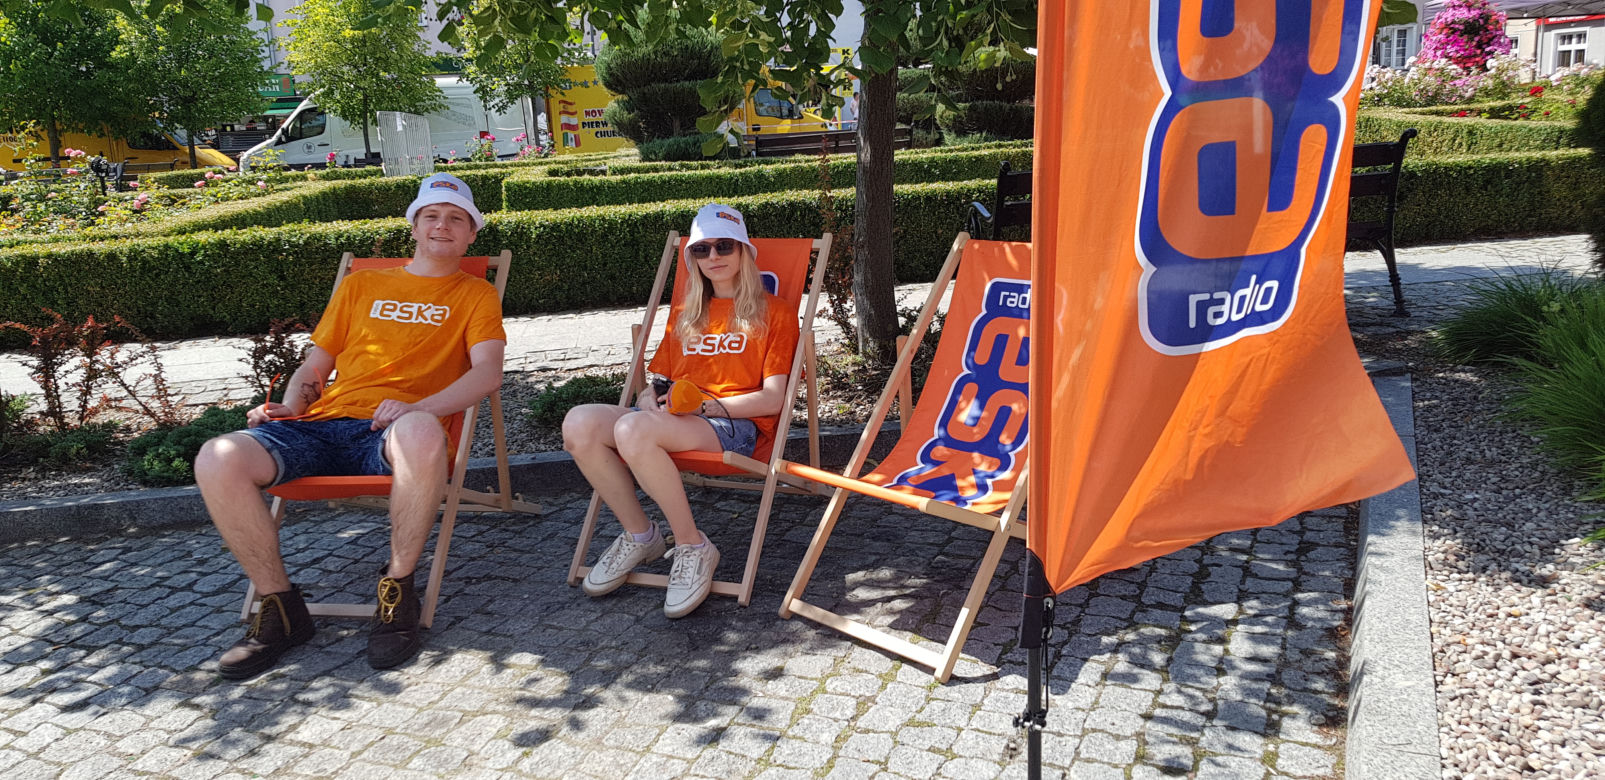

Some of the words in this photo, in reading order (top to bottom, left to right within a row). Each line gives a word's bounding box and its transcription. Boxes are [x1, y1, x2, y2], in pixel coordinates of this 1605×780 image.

[1188, 274, 1279, 329] radio
[378, 302, 449, 325] eska
[686, 332, 746, 354] eska
